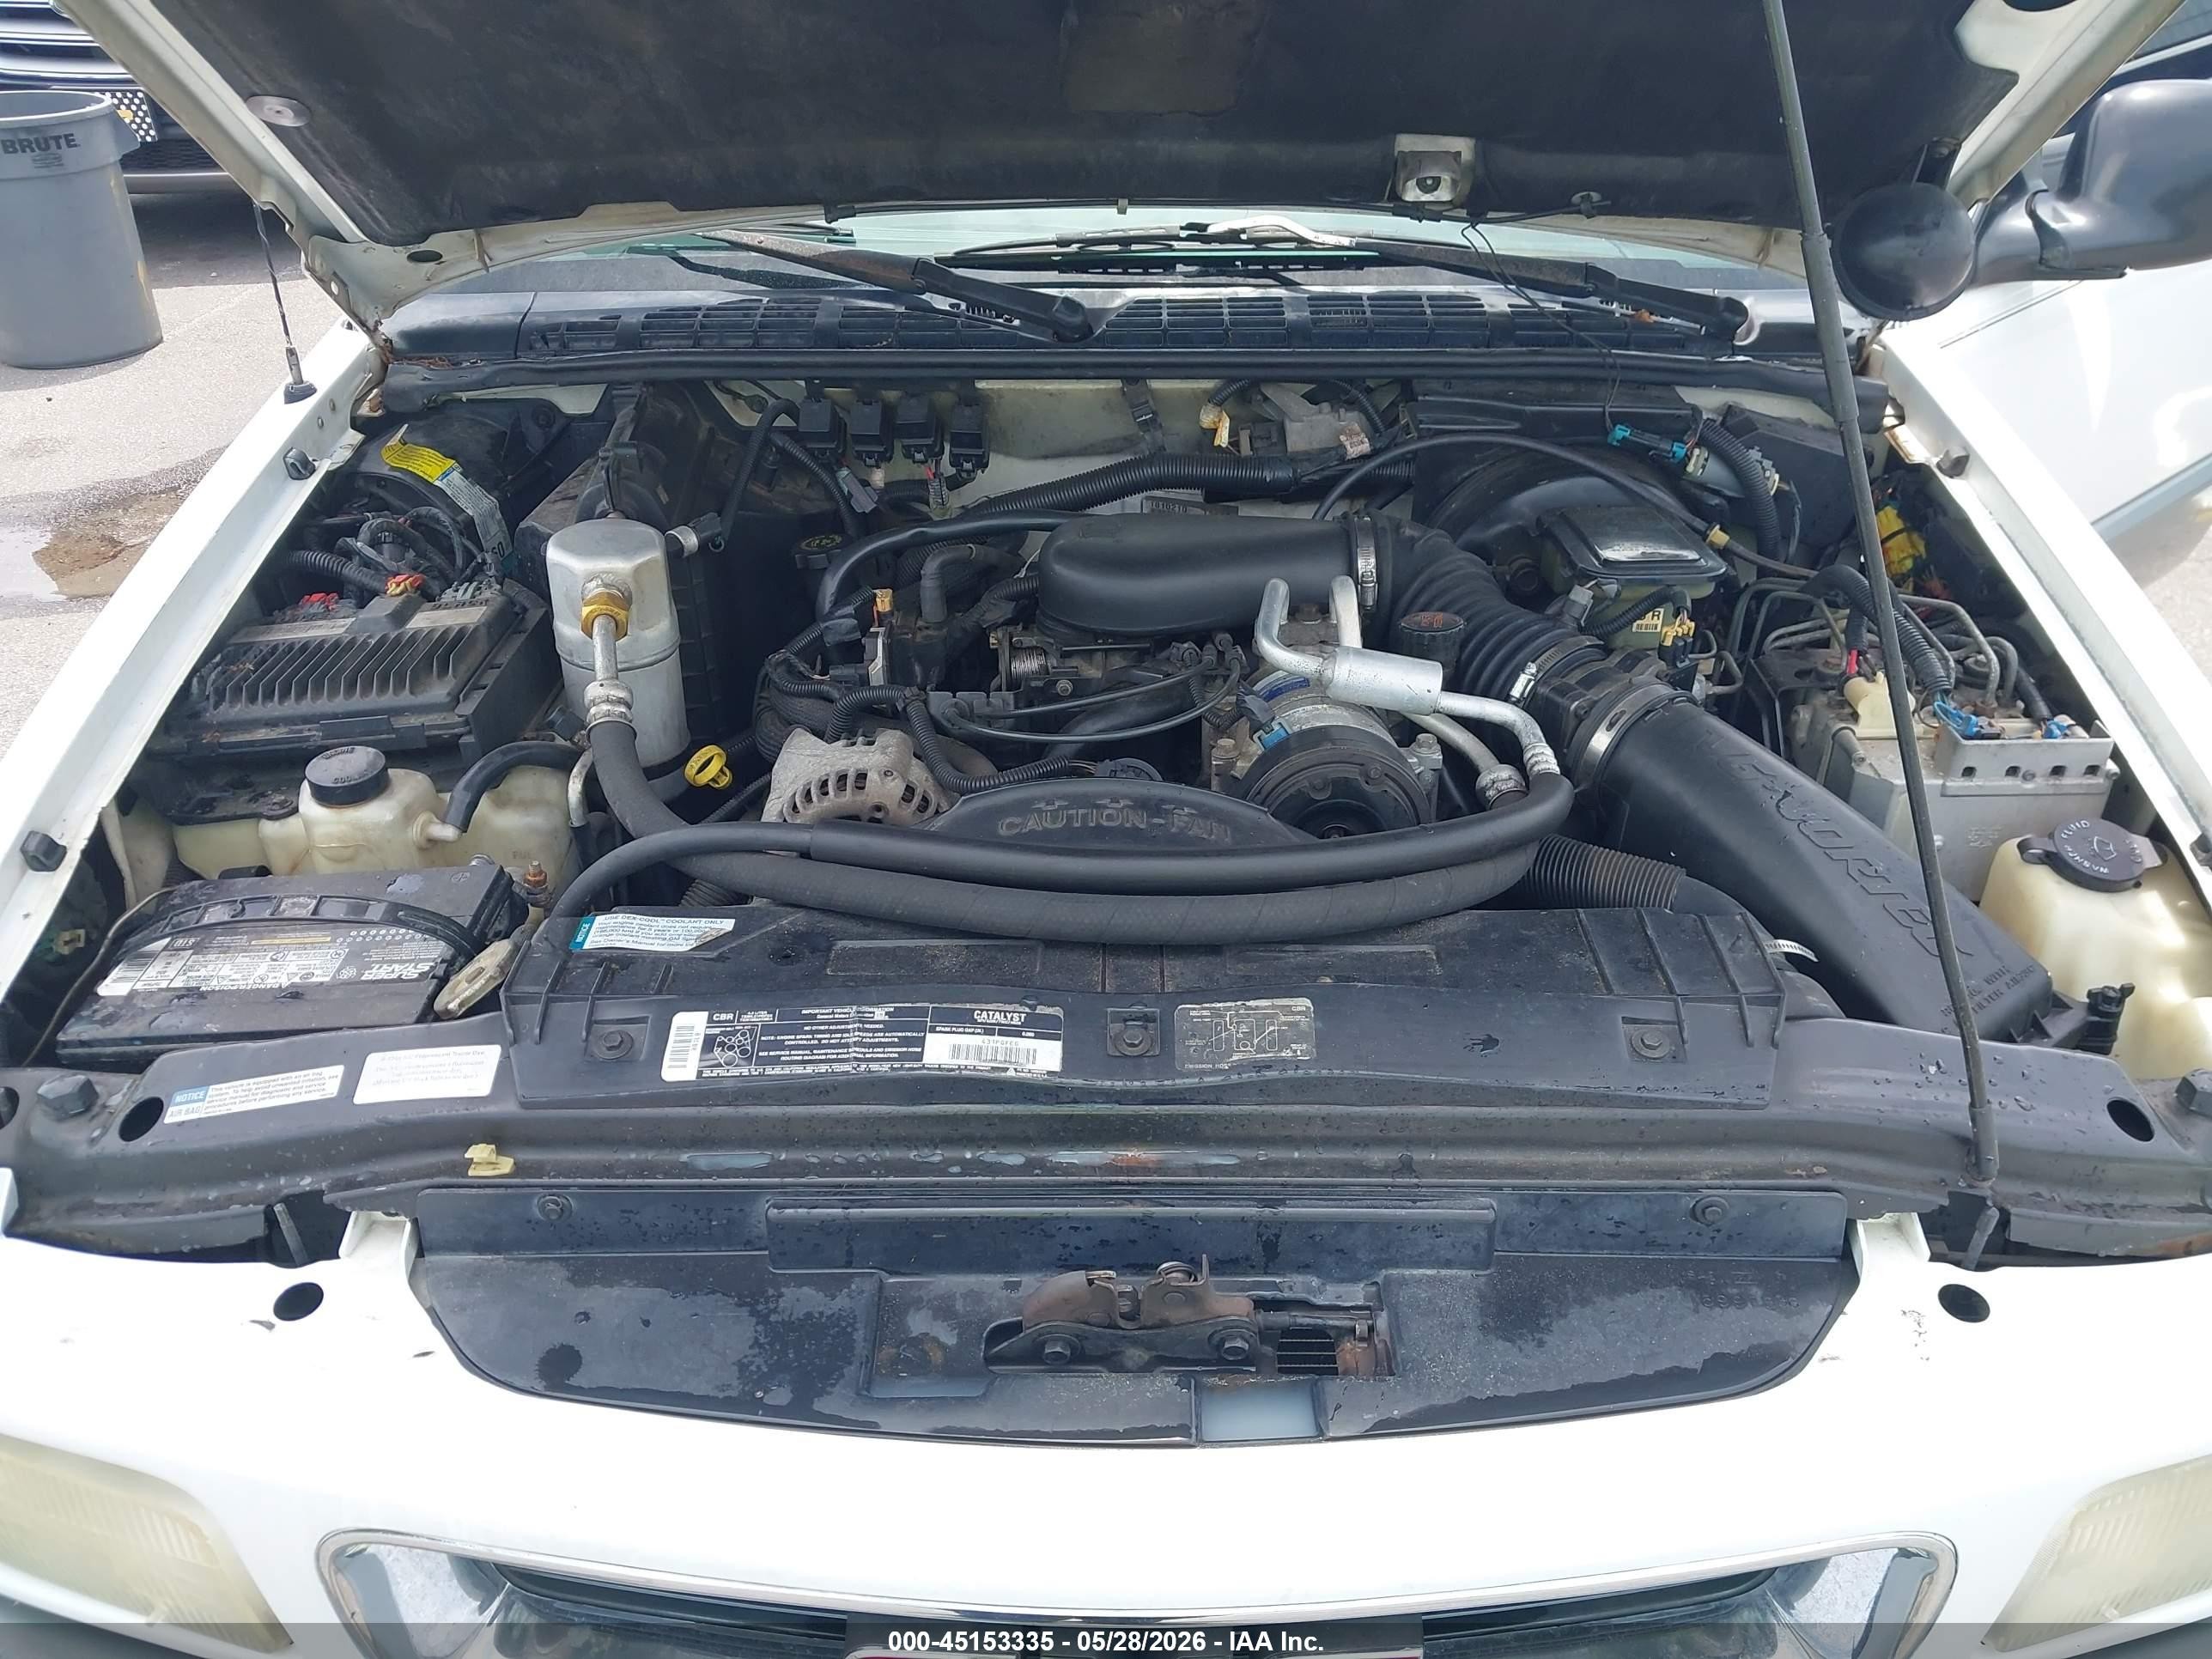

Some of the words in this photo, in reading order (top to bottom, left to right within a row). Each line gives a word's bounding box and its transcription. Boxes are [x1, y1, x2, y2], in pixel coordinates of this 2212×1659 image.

[1, 133, 77, 154] BRUTE
[2061, 819, 2090, 839] FLUID
[575, 922, 591, 943] NOTICE
[173, 939, 196, 947] STD
[361, 970, 420, 980] SUPER
[713, 1012, 734, 1022] CBR
[974, 1010, 1026, 1023] CATALYST
[174, 1091, 205, 1103] NOTICE
[169, 1108, 183, 1118] AIR
[184, 1106, 201, 1115] BAG
